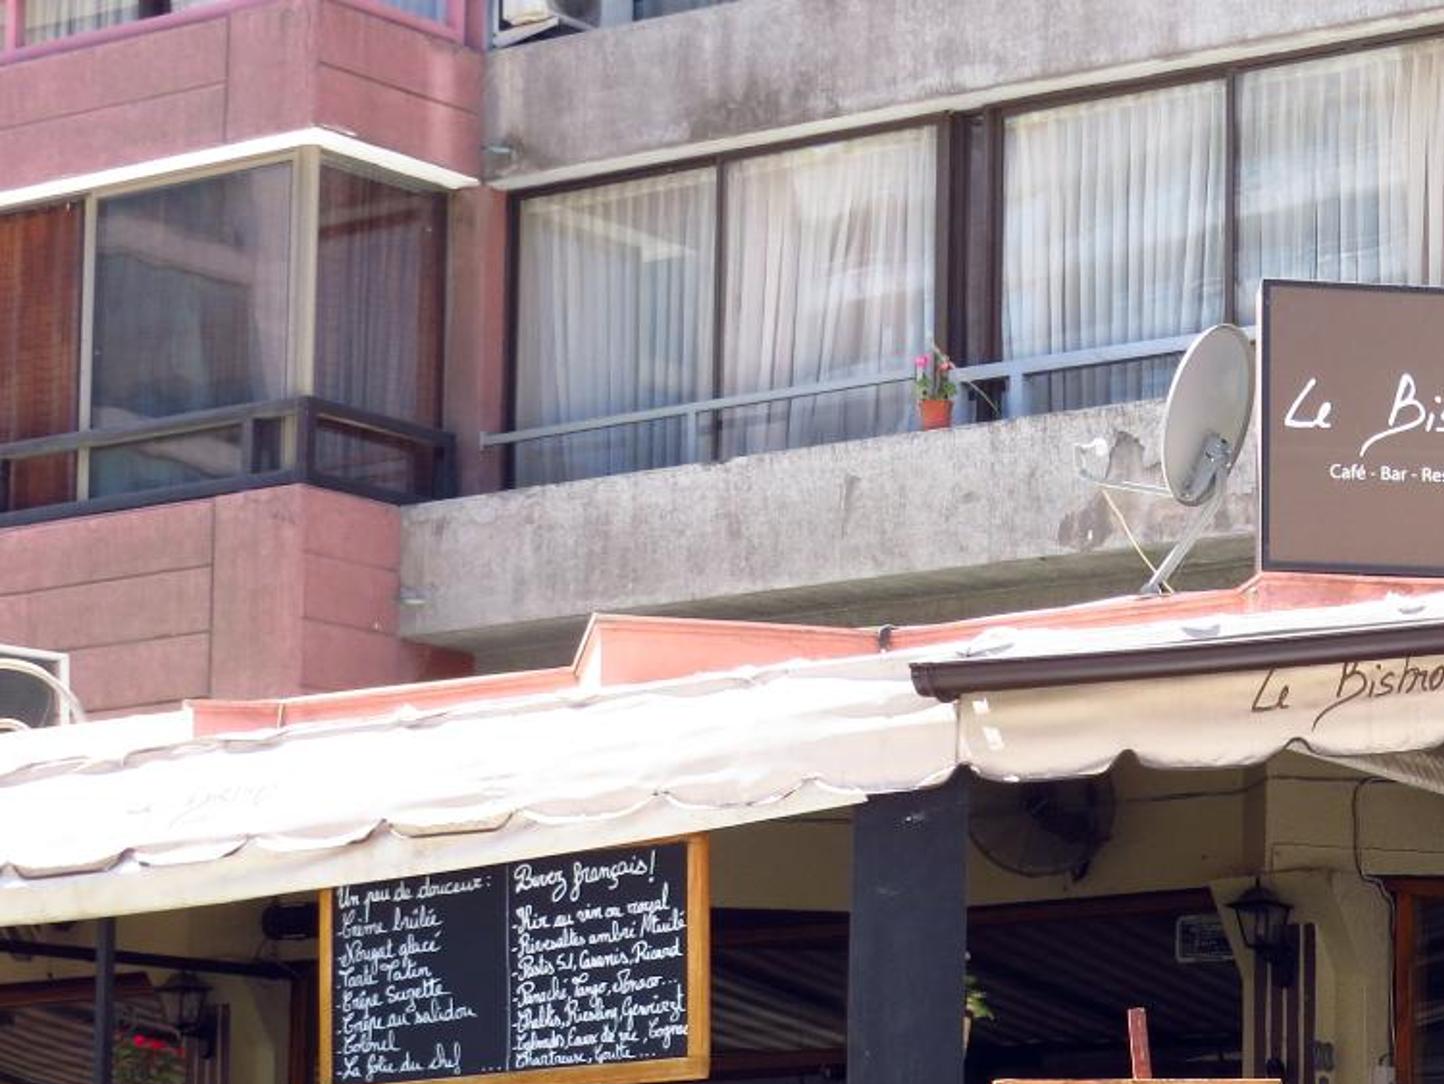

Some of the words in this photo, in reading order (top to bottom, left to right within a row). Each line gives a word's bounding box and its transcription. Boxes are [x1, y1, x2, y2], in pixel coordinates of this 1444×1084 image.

[1284, 378, 1332, 428] Le
[1329, 464, 1366, 480] Café
[1380, 466, 1406, 481] Bar
[1251, 667, 1289, 712] Le
[364, 889, 391, 922] peu
[393, 880, 412, 901] de
